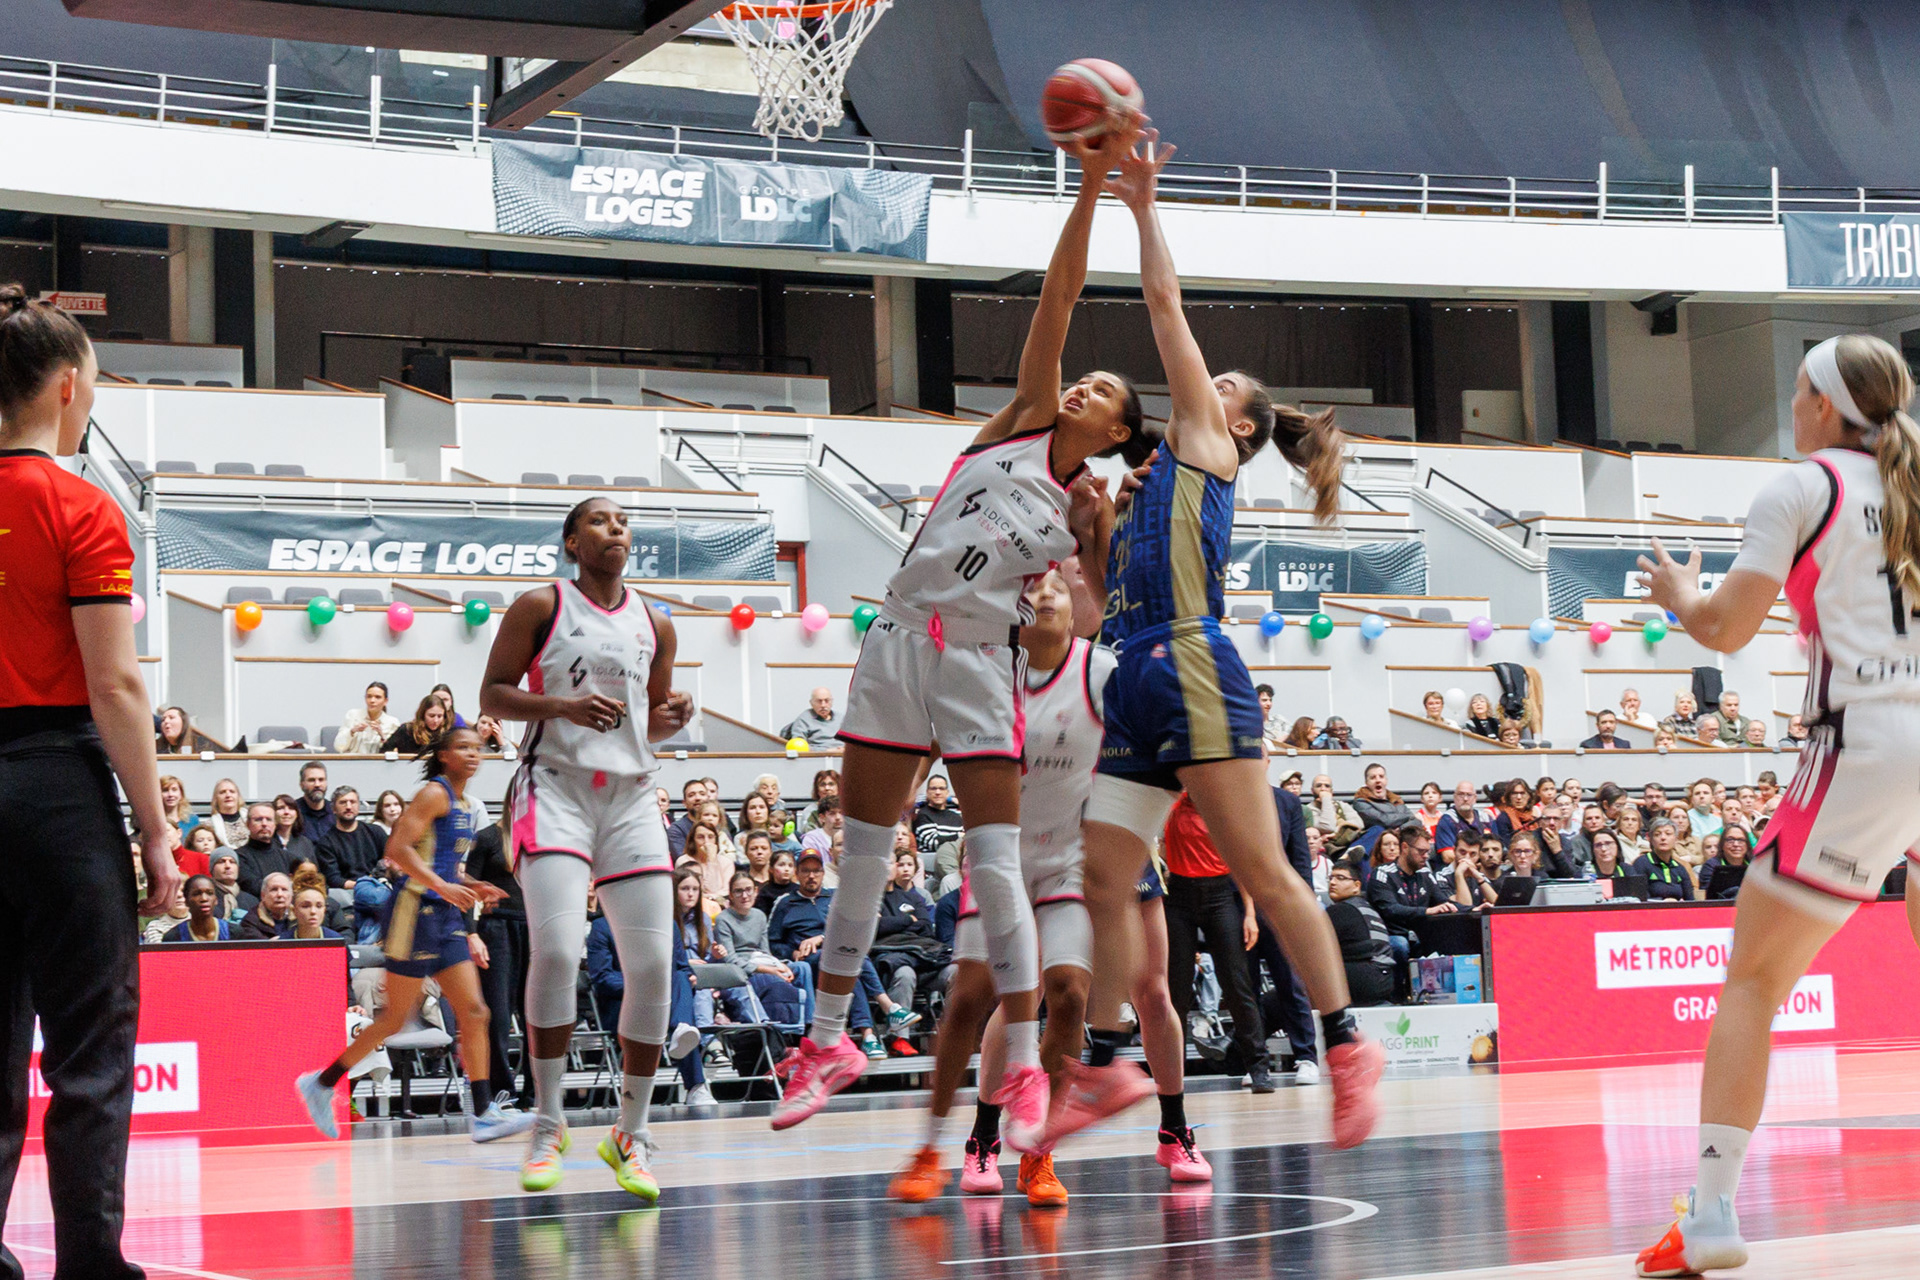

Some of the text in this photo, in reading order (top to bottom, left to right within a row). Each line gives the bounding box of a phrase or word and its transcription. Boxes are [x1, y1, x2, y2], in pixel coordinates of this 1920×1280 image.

[570, 164, 706, 198] ESPACE
[739, 185, 811, 197] GROUPE
[584, 195, 694, 228] LOGES
[740, 195, 812, 222] LDLC
[56, 297, 104, 310] BUVETTE
[983, 506, 1010, 531] LDLC
[268, 539, 559, 576] ESPACE LOGES
[630, 545, 659, 554] UPE
[621, 555, 659, 578] LC
[954, 545, 989, 582] 10
[1278, 562, 1335, 571] GROUPE
[1278, 571, 1334, 592] LDLC
[1609, 944, 1730, 972] MÉTROPOL
[1673, 991, 1822, 1022] GRA YON
[1404, 1035, 1439, 1049] PRINT
[134, 1063, 178, 1093] ON
